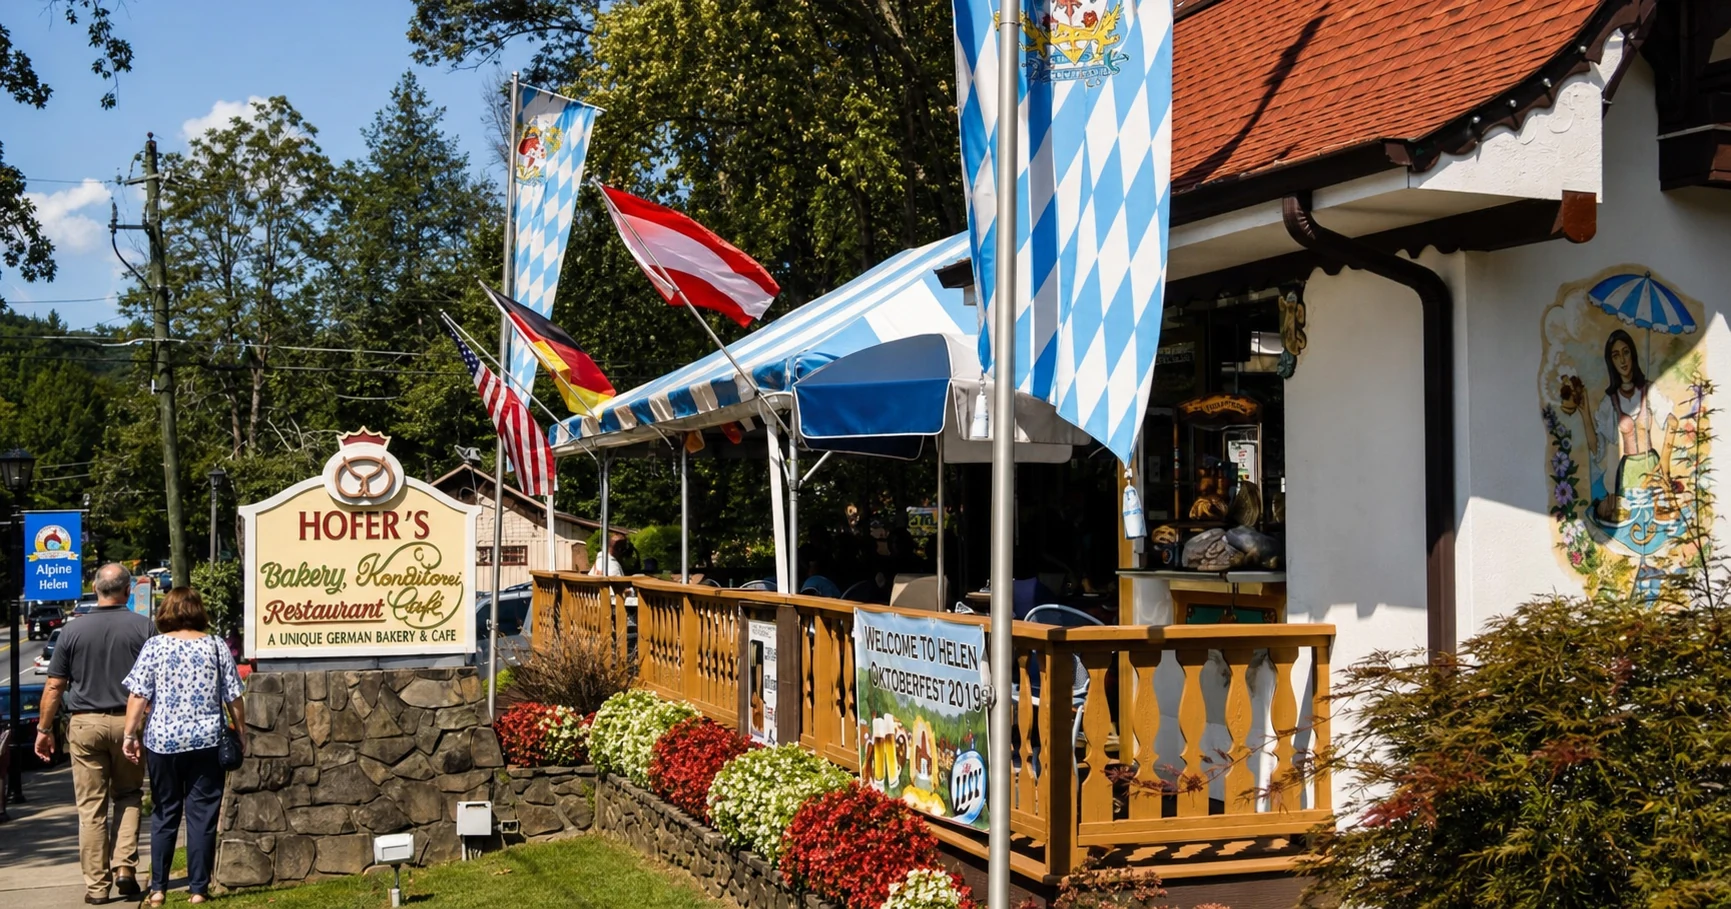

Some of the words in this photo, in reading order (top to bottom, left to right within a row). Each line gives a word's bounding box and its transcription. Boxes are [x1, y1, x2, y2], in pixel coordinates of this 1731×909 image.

[299, 510, 430, 541] HOFER'S
[36, 563, 72, 577] Alpine
[39, 578, 68, 590] Helen
[260, 561, 347, 595] Bakery,
[355, 541, 463, 588] Konditorei
[263, 598, 386, 625] Restaurant
[387, 586, 445, 623] Café
[267, 632, 276, 646] A
[280, 632, 323, 648] UNIQUE
[326, 631, 372, 645] GERMAN
[376, 630, 416, 643] BAKERY
[419, 629, 428, 642] &
[432, 629, 456, 642] CAFE
[864, 626, 918, 660] WELCOME
[920, 635, 935, 662] TO
[938, 638, 978, 671] HELEN
[868, 661, 945, 704] OKTOBERFEST
[948, 679, 981, 711] 2019
